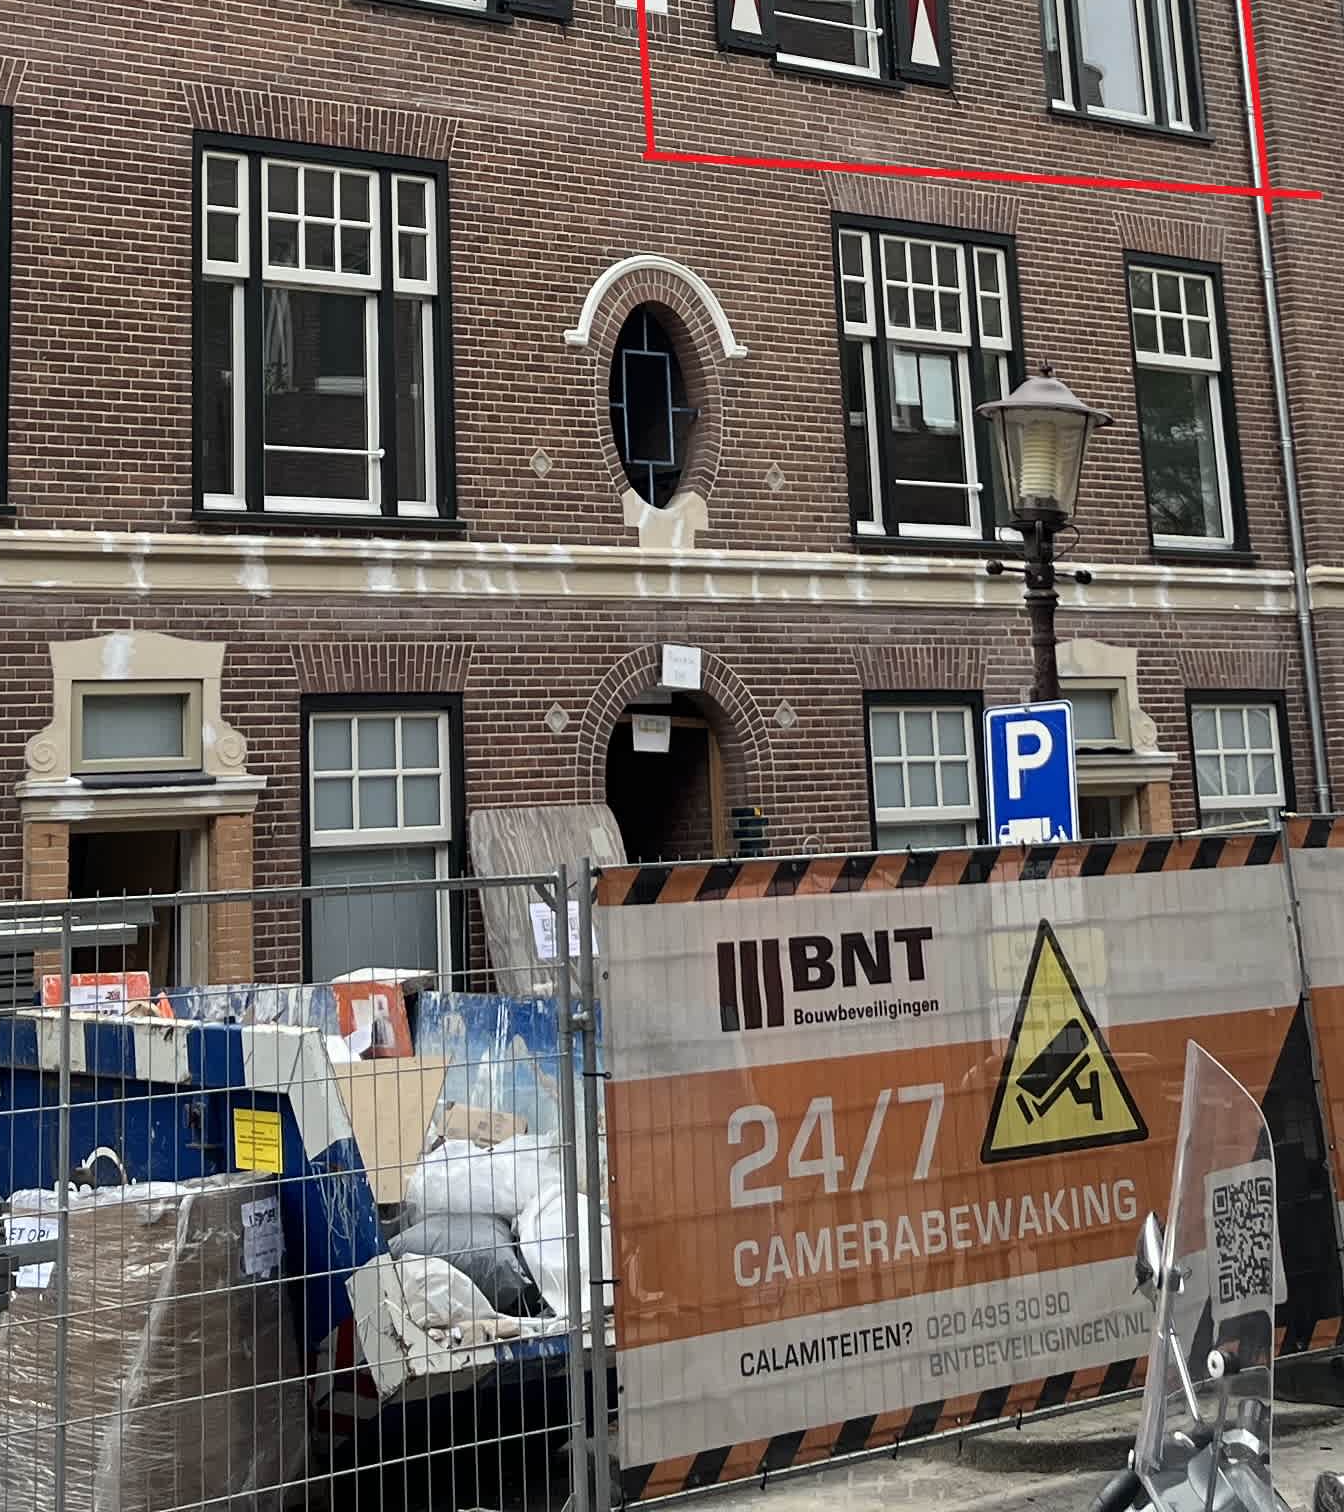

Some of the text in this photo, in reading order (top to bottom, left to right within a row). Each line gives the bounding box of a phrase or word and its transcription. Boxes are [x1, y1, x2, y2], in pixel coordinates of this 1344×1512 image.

[1006, 720, 1053, 800] P
[788, 926, 934, 992] BNT
[793, 998, 940, 1025] Bouwbeveiligingen
[727, 1082, 945, 1209] 24/7
[733, 1178, 1138, 1288] CAMERABEWAKING
[740, 1291, 1070, 1377] CALAMITEITEN? 020 495 30 90
[928, 1311, 1150, 1377] BNTBEVEILIGINGEN.NL
